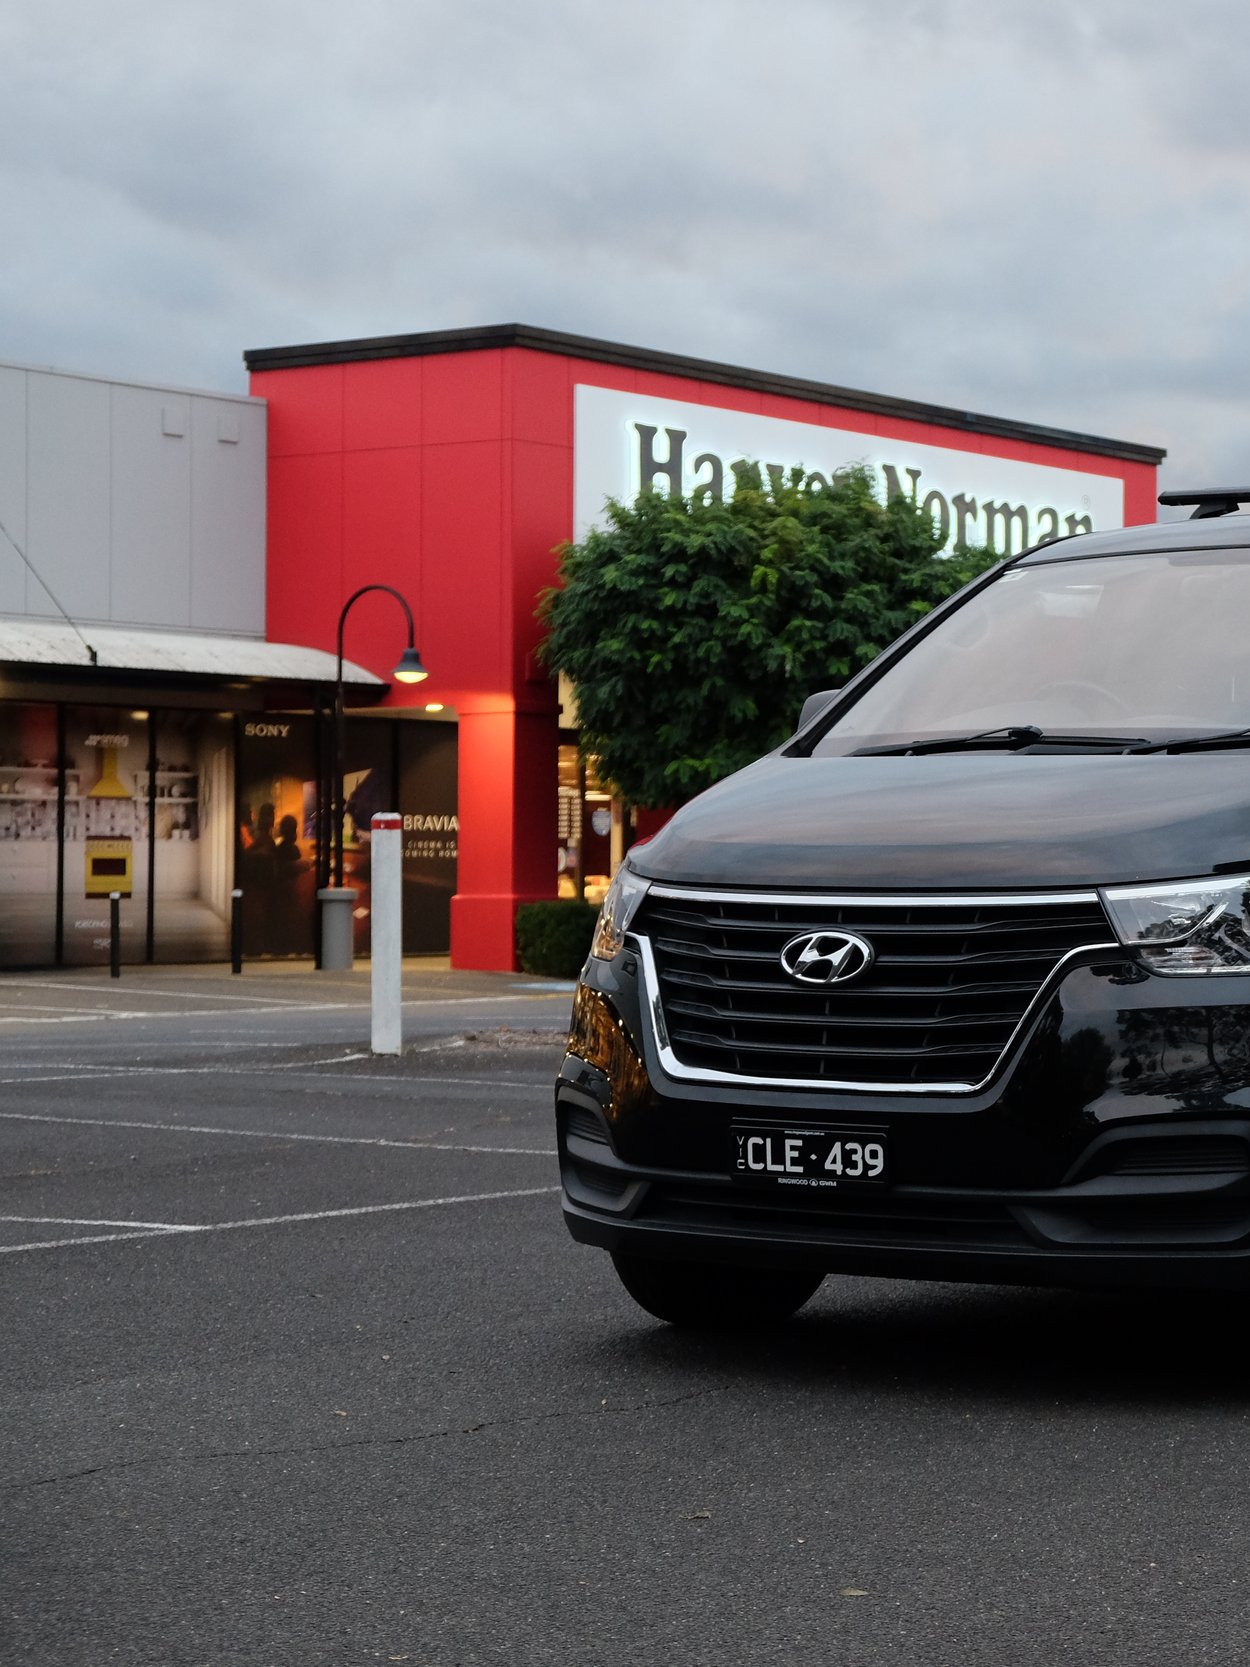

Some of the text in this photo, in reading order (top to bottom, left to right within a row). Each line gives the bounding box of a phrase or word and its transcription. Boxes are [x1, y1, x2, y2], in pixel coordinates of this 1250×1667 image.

[244, 723, 290, 737] SONY
[403, 814, 458, 831] BRAVIA
[438, 850, 458, 858] HOM
[747, 1136, 884, 1177] CLE 439
